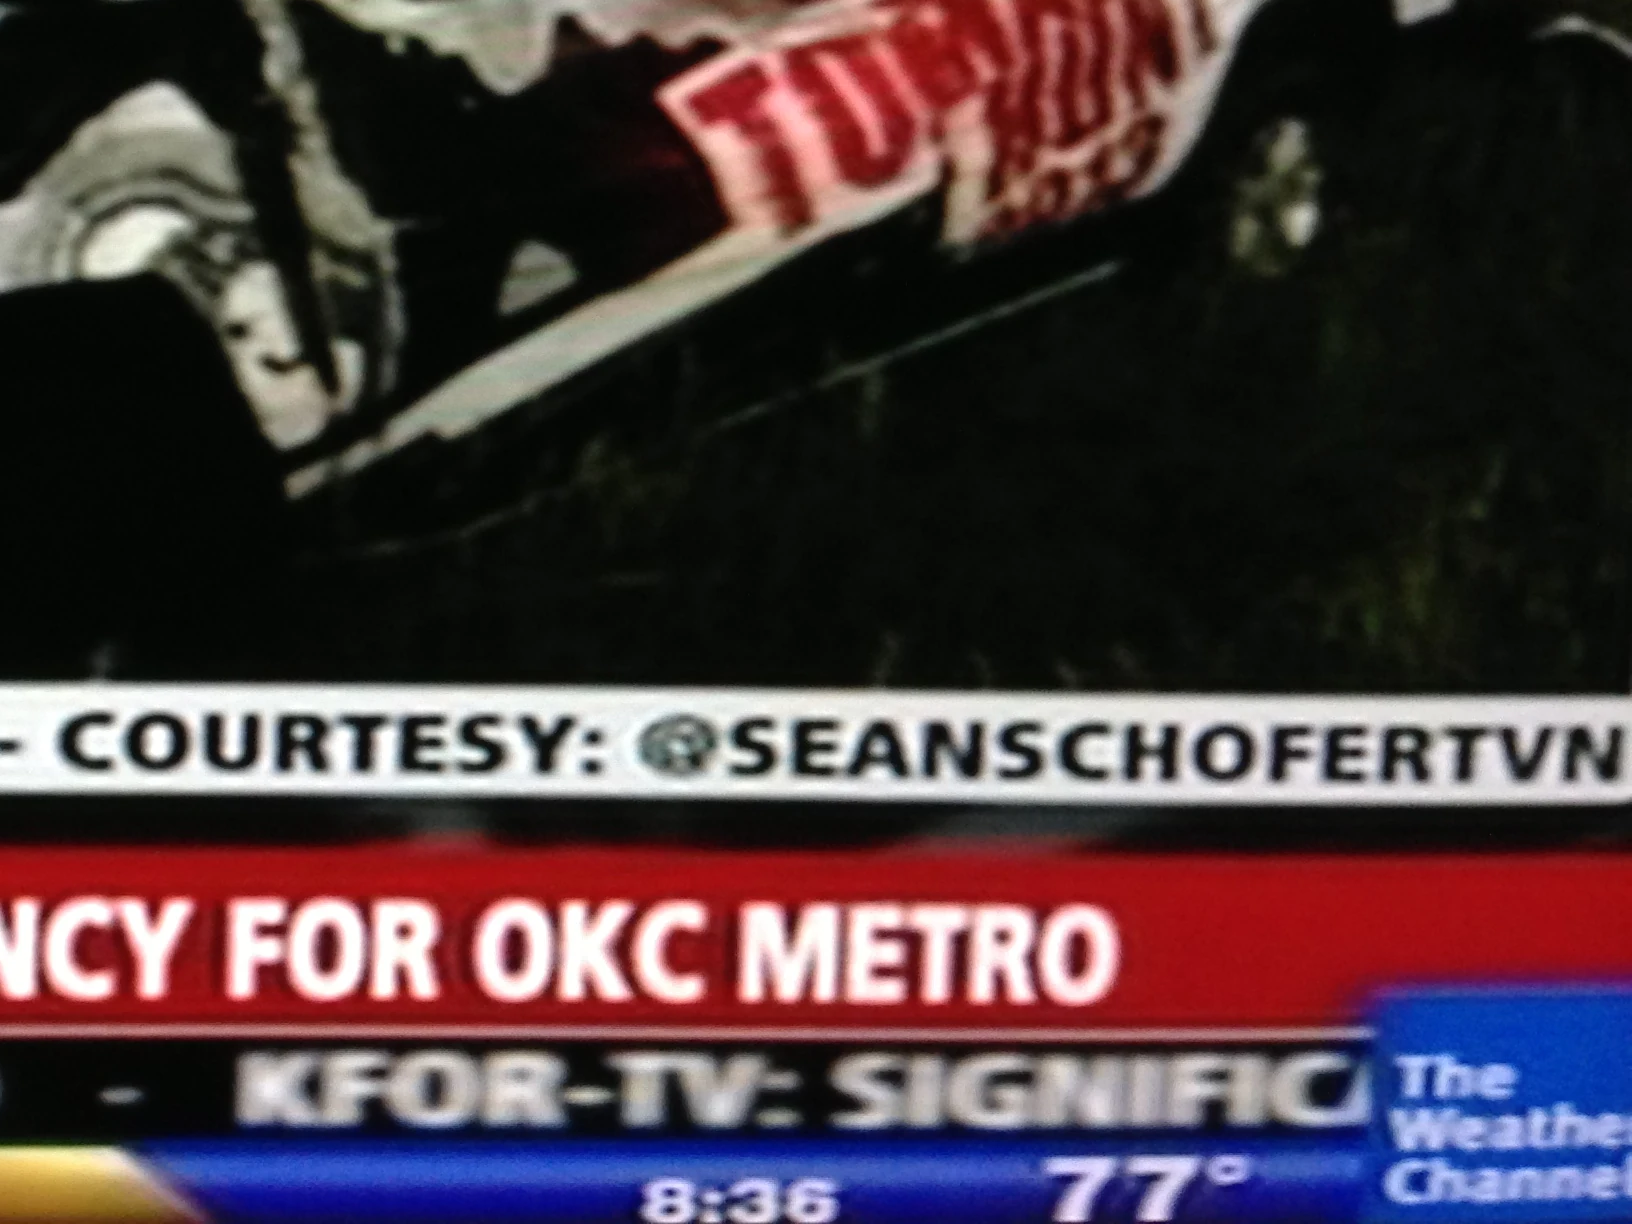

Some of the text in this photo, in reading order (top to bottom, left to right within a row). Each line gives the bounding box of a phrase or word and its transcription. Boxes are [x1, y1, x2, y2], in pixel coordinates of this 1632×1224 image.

[57, 710, 606, 776] COURTESY:
[634, 711, 1624, 784] @SEANSCHOFERTVN
[224, 897, 440, 1002] FOR
[473, 897, 708, 1004] OKC
[734, 900, 1121, 1007] METRO
[234, 1051, 800, 1128] KFOR-TV:
[1392, 1052, 1520, 1101] The
[1388, 1101, 1632, 1152] Weathe
[640, 1177, 841, 1224] 8:36
[1040, 1155, 1255, 1224] 77°
